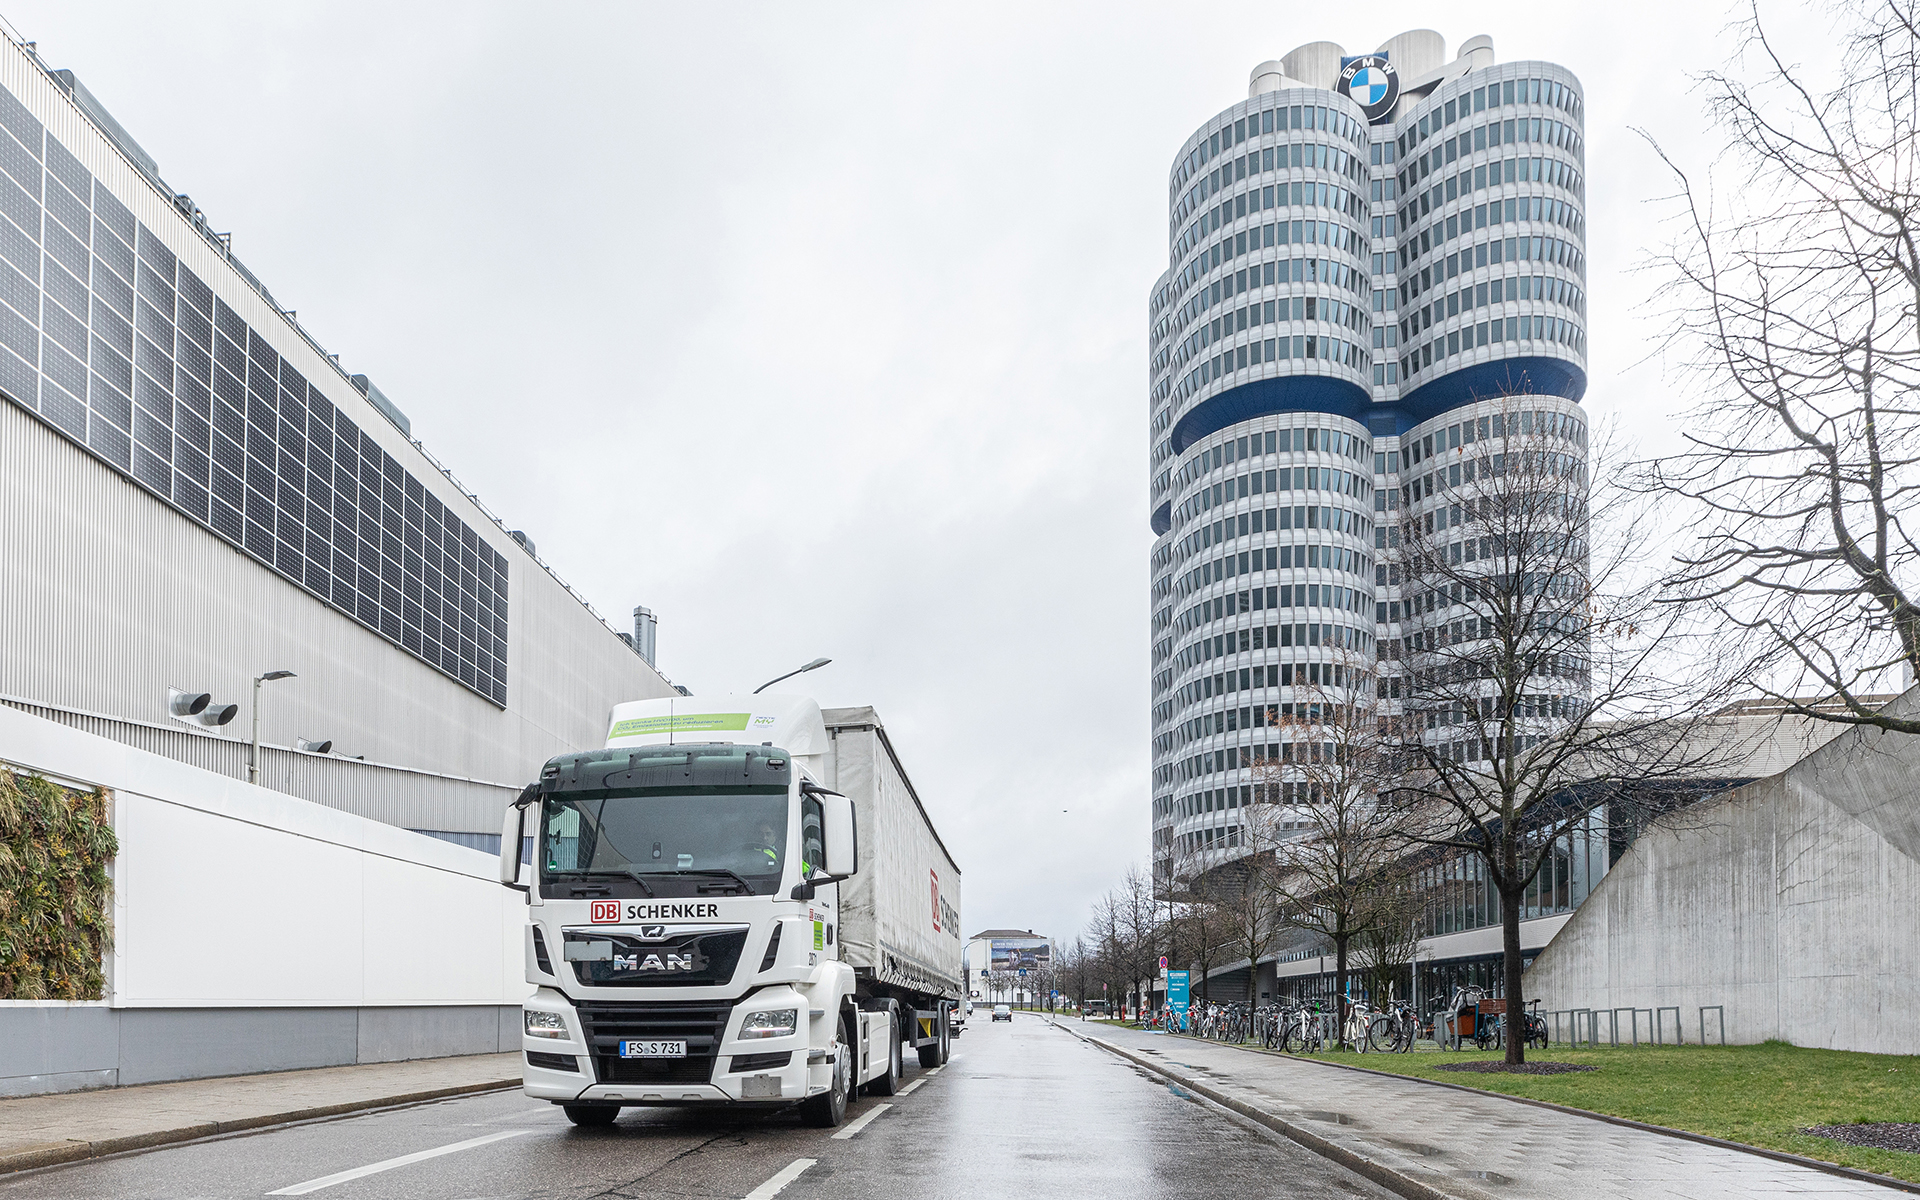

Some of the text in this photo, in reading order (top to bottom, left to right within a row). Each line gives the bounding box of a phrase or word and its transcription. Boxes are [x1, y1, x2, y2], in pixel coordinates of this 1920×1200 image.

[1342, 57, 1394, 80] BMW
[593, 903, 719, 920] DB SCHENKER
[613, 953, 692, 971] MAN
[629, 1042, 681, 1054] FS S 731
